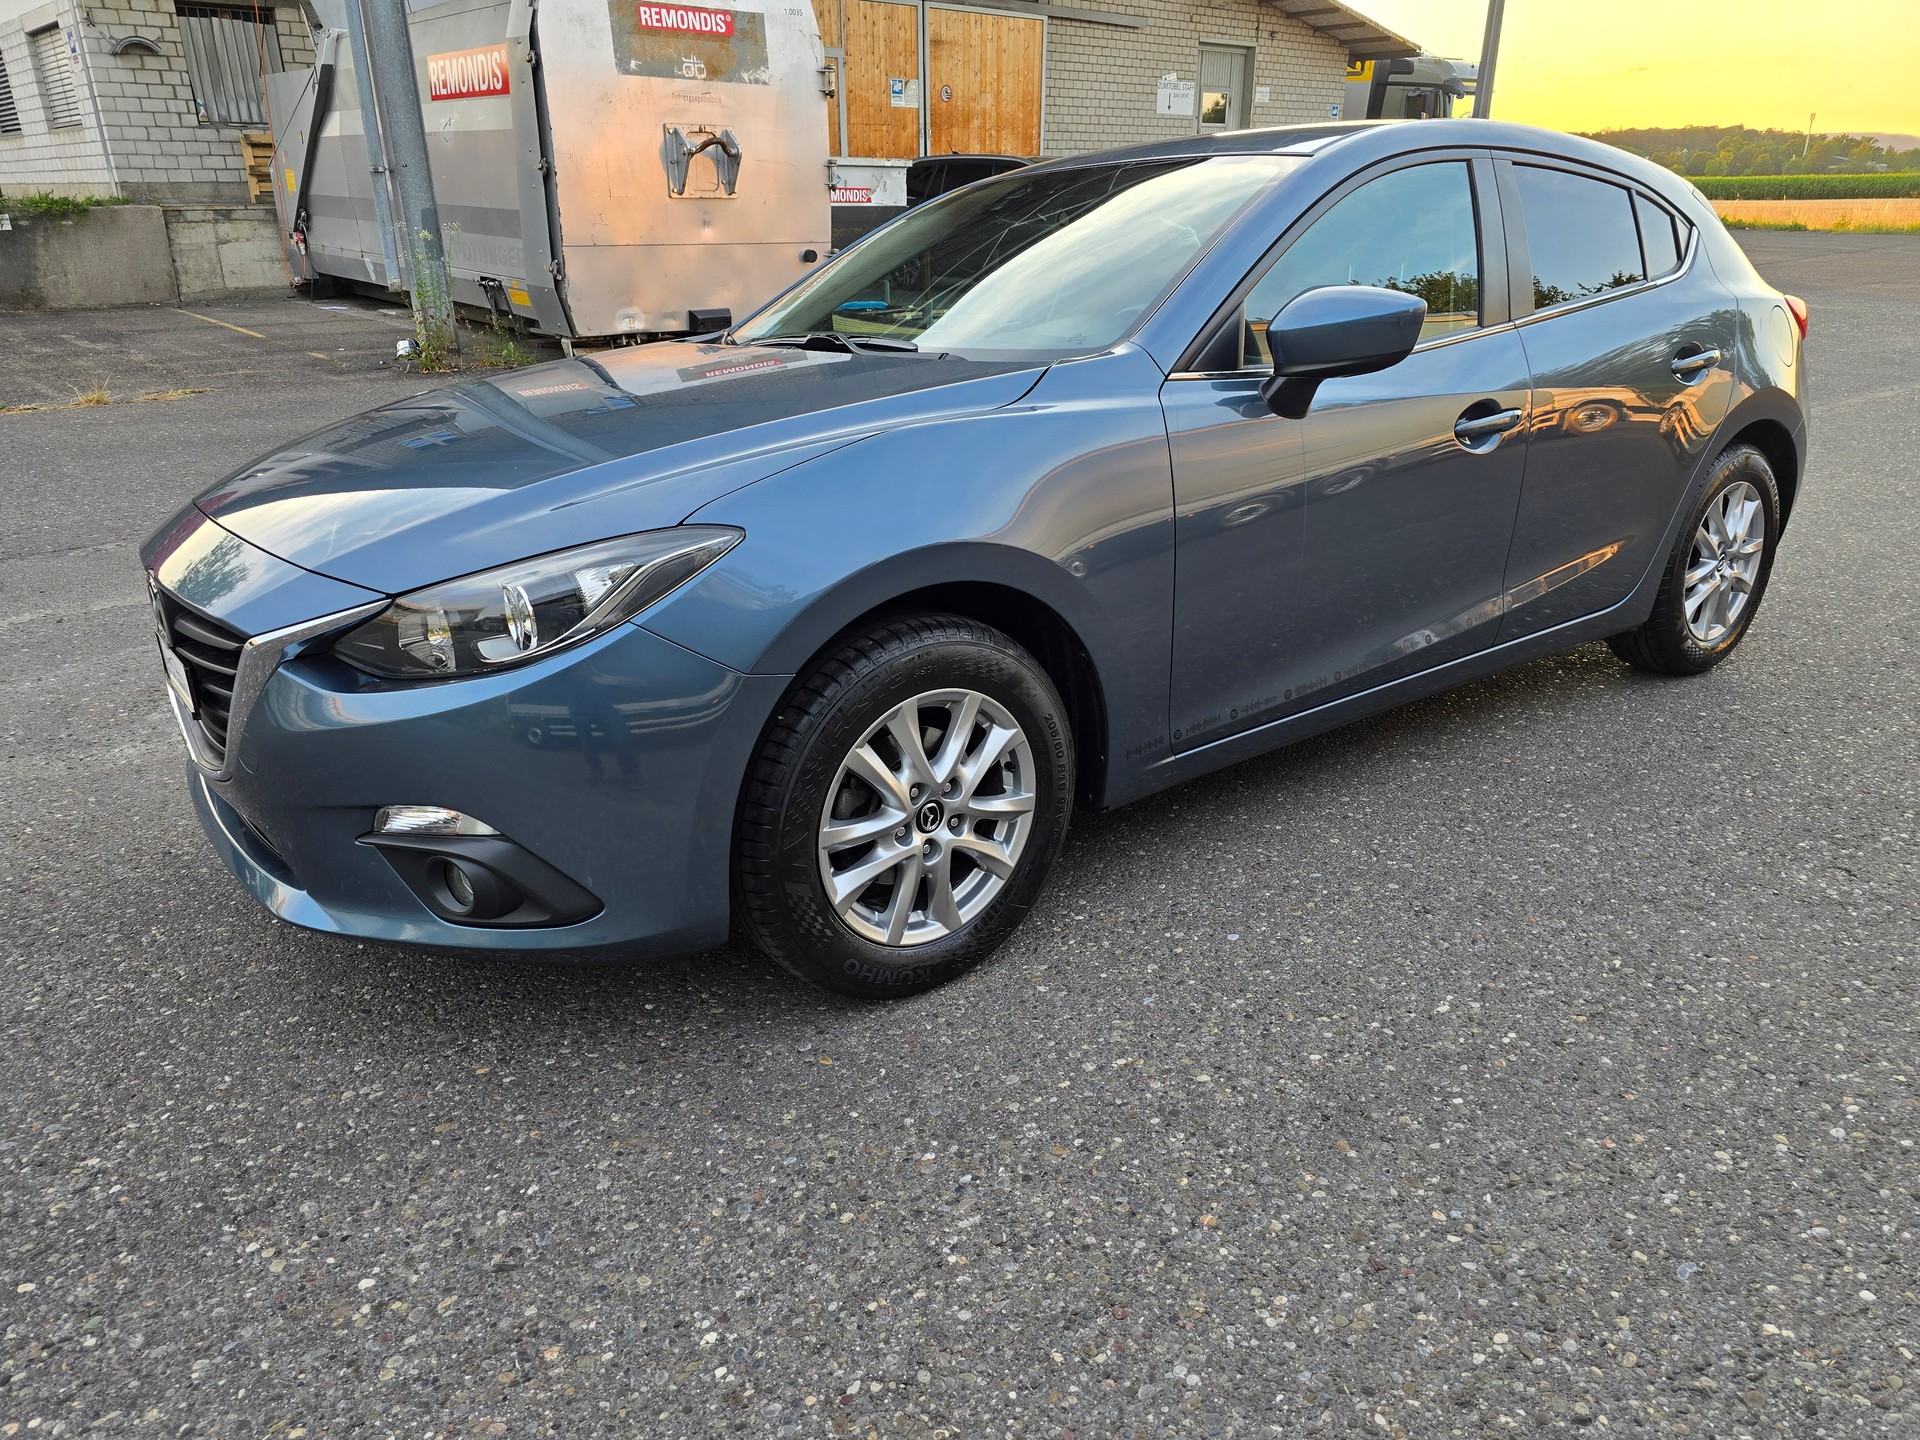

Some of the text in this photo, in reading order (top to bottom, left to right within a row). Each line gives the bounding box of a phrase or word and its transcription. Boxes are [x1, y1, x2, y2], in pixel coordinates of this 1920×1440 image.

[830, 189, 869, 202] MONDIS
[1043, 712, 1066, 759] 205/60
[843, 957, 932, 985] KUMHO
